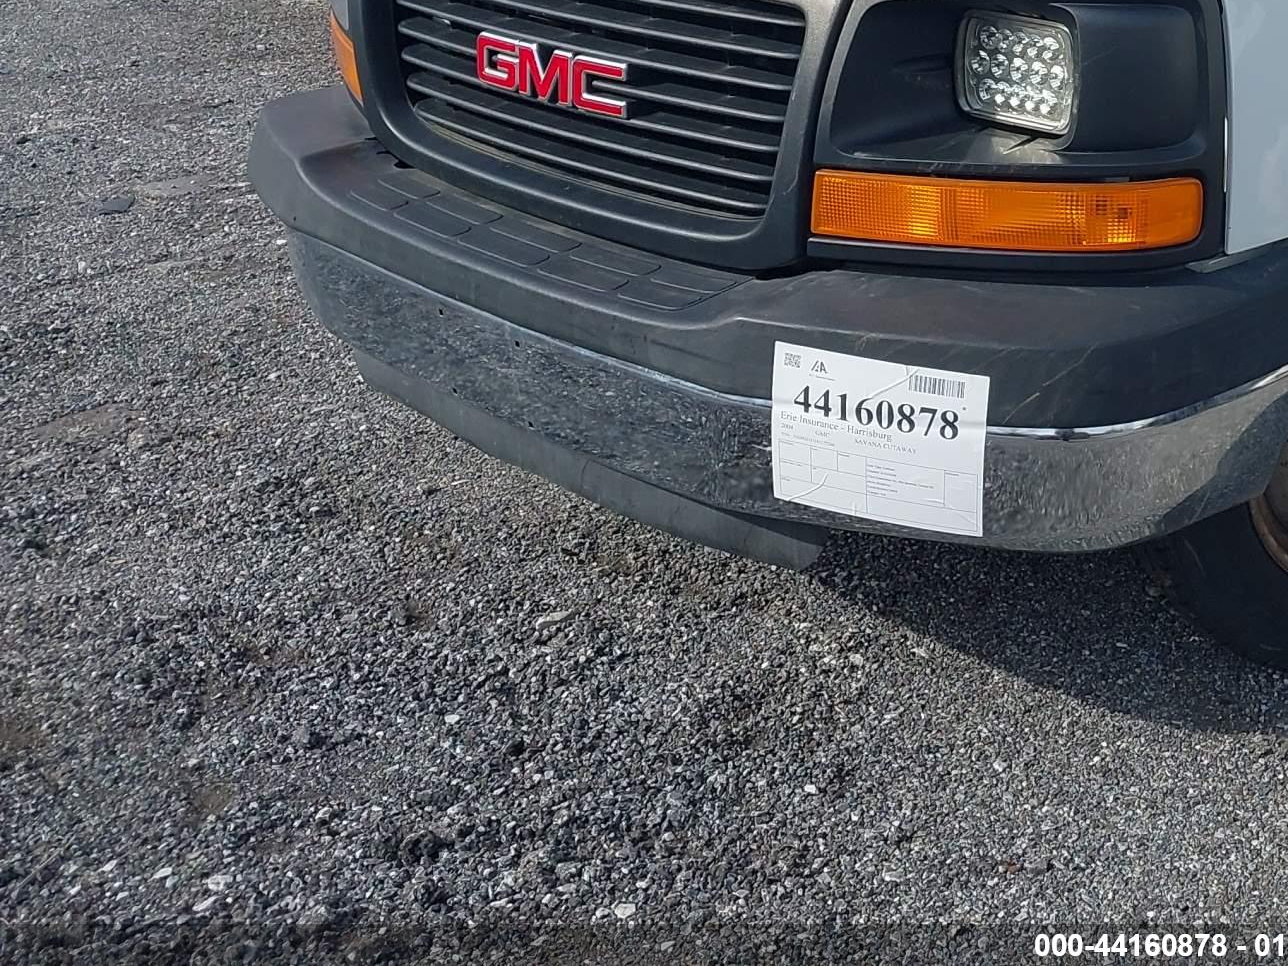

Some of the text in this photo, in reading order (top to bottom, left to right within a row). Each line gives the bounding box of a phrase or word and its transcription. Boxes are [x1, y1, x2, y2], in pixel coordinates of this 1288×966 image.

[476, 31, 627, 118] GMC
[780, 410, 797, 421] Erie
[799, 414, 839, 431] Insurance
[847, 423, 893, 443] Harrisburg
[793, 385, 959, 440] 44160878
